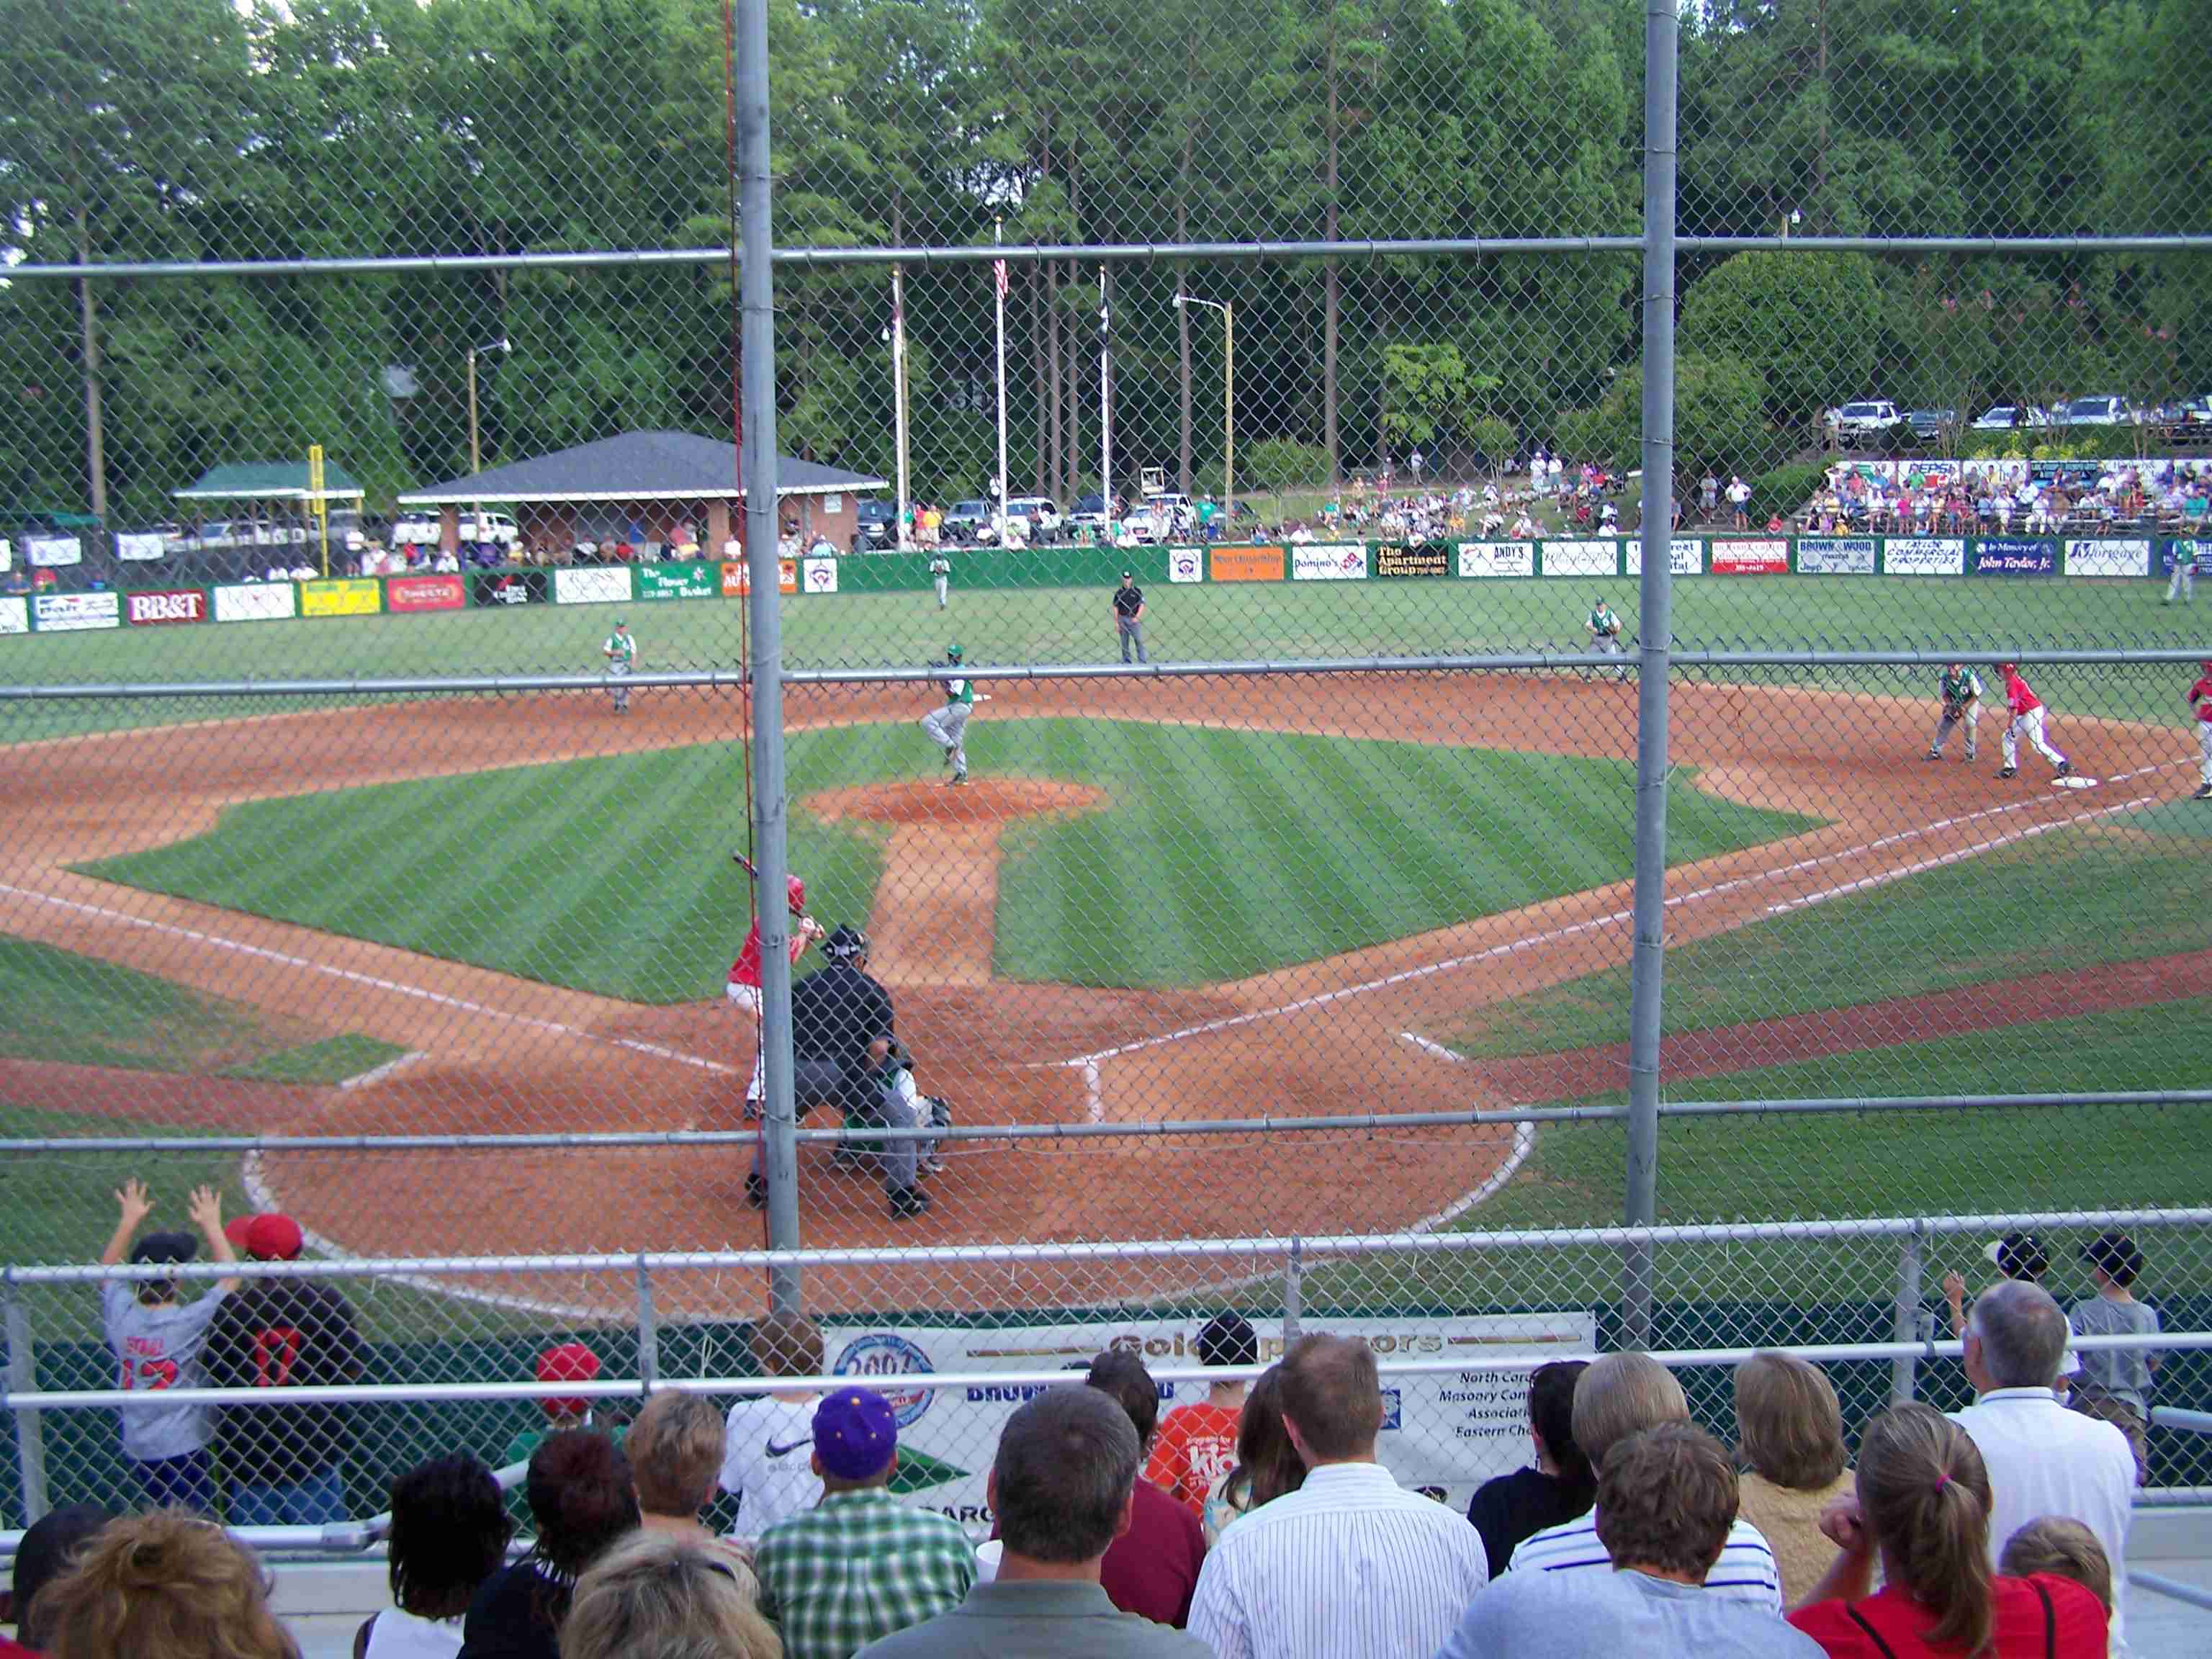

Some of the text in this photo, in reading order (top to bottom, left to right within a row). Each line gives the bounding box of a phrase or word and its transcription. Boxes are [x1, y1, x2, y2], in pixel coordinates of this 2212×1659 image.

[1378, 547, 1402, 556] The
[1494, 546, 1524, 559] ANDY'S
[1800, 541, 1833, 552] BROWN
[1843, 541, 1871, 552] WOOD
[1295, 557, 1339, 567] Domino's
[1378, 555, 1447, 565] Apartment
[1978, 556, 2051, 570] John Taylor, Jr.
[1378, 565, 1416, 575] Group
[132, 593, 202, 621] BB&T
[1460, 1371, 1498, 1383] North
[1440, 1390, 1497, 1403] Masonry
[1469, 1407, 1529, 1419] Associati
[1455, 1426, 1506, 1438] Eastern
